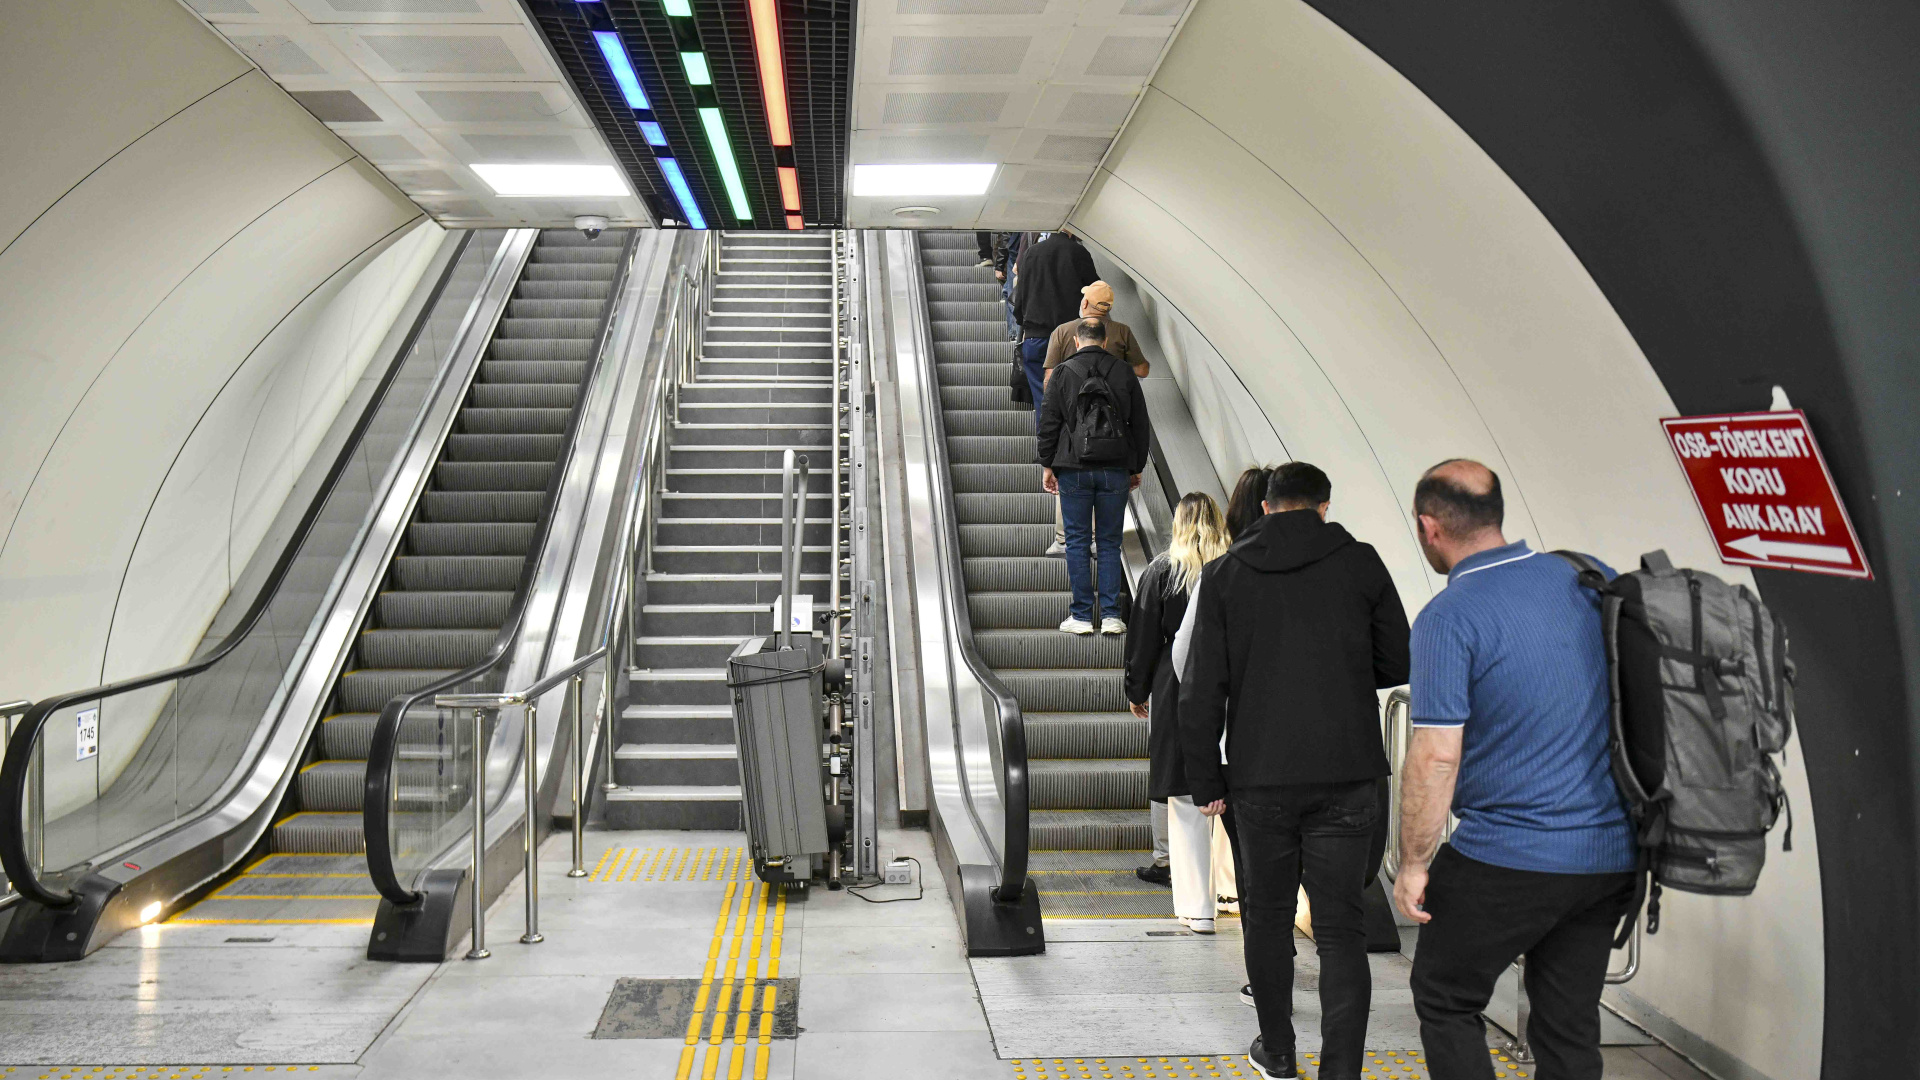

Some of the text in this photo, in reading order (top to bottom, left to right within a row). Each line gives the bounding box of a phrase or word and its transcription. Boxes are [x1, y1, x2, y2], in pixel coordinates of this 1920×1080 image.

[1674, 426, 1810, 458] OSB-TÖREKENT
[1720, 467, 1786, 496] KORU
[1722, 503, 1826, 536] ANKARAY
[80, 726, 95, 742] 1745
